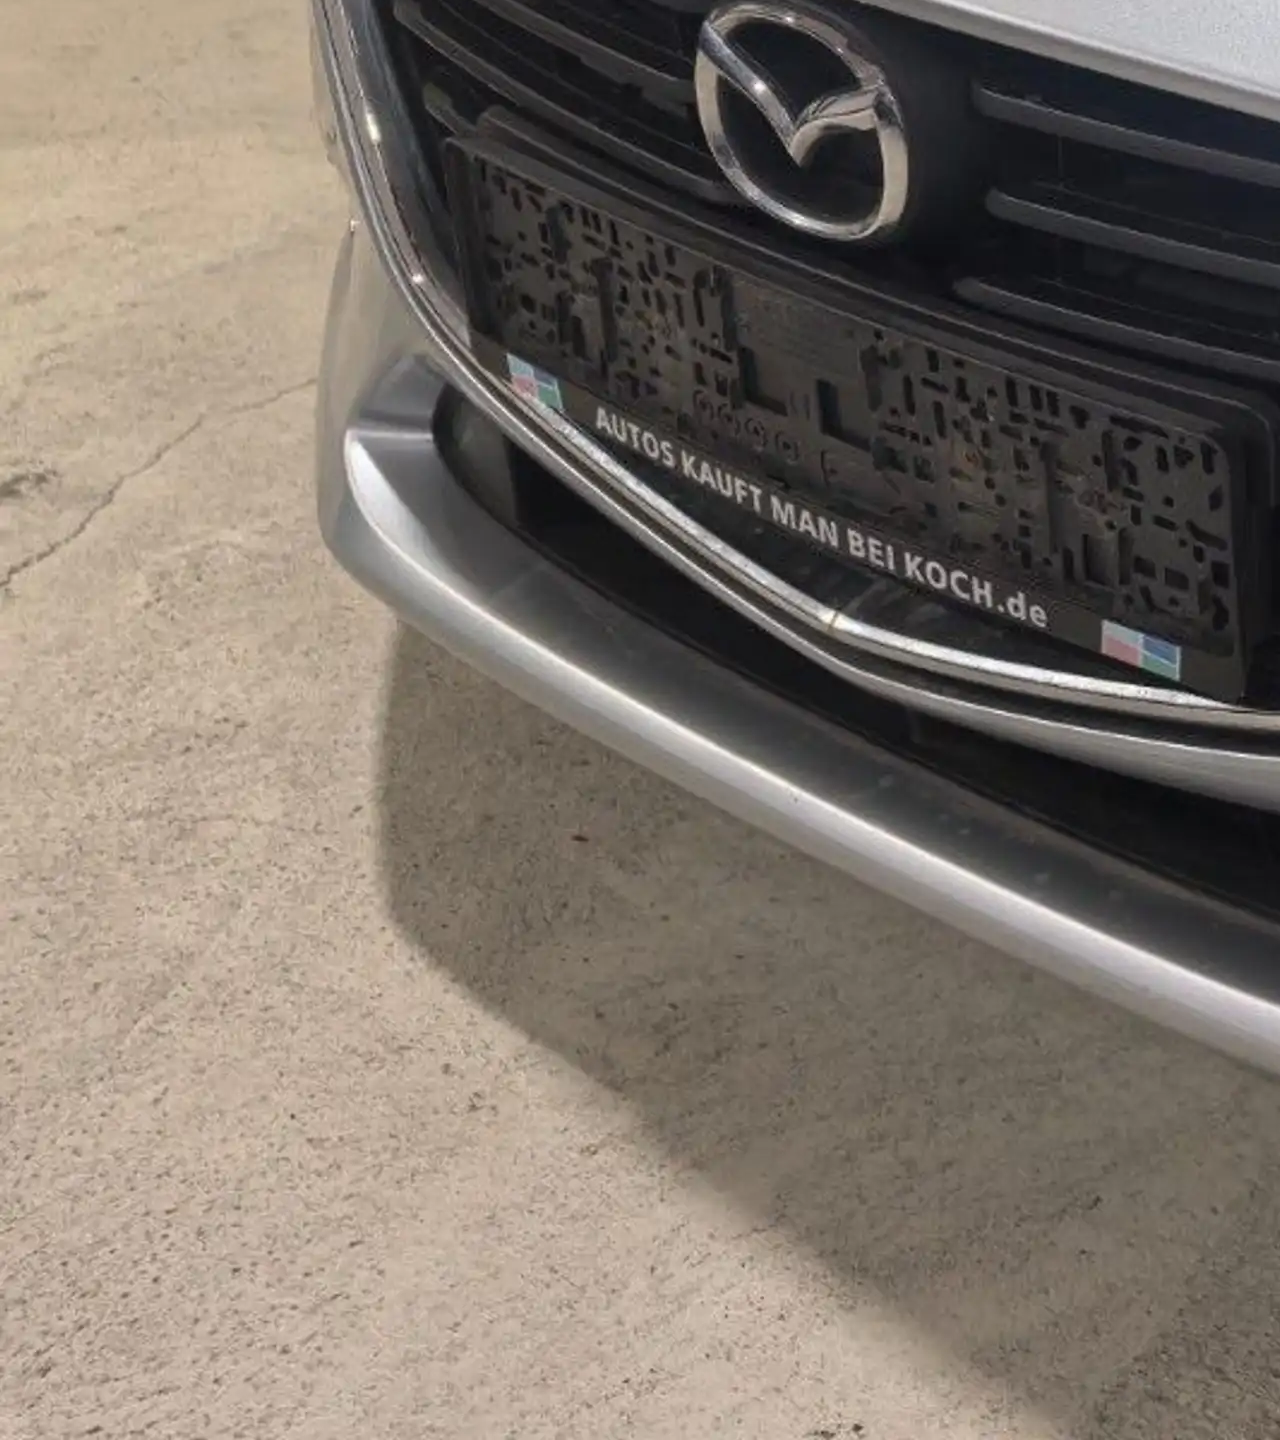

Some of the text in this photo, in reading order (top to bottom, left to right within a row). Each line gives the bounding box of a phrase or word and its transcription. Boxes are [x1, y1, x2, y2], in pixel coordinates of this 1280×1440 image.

[596, 407, 1048, 628] AUTOS KAUFT MAN BEI KOCH.de
